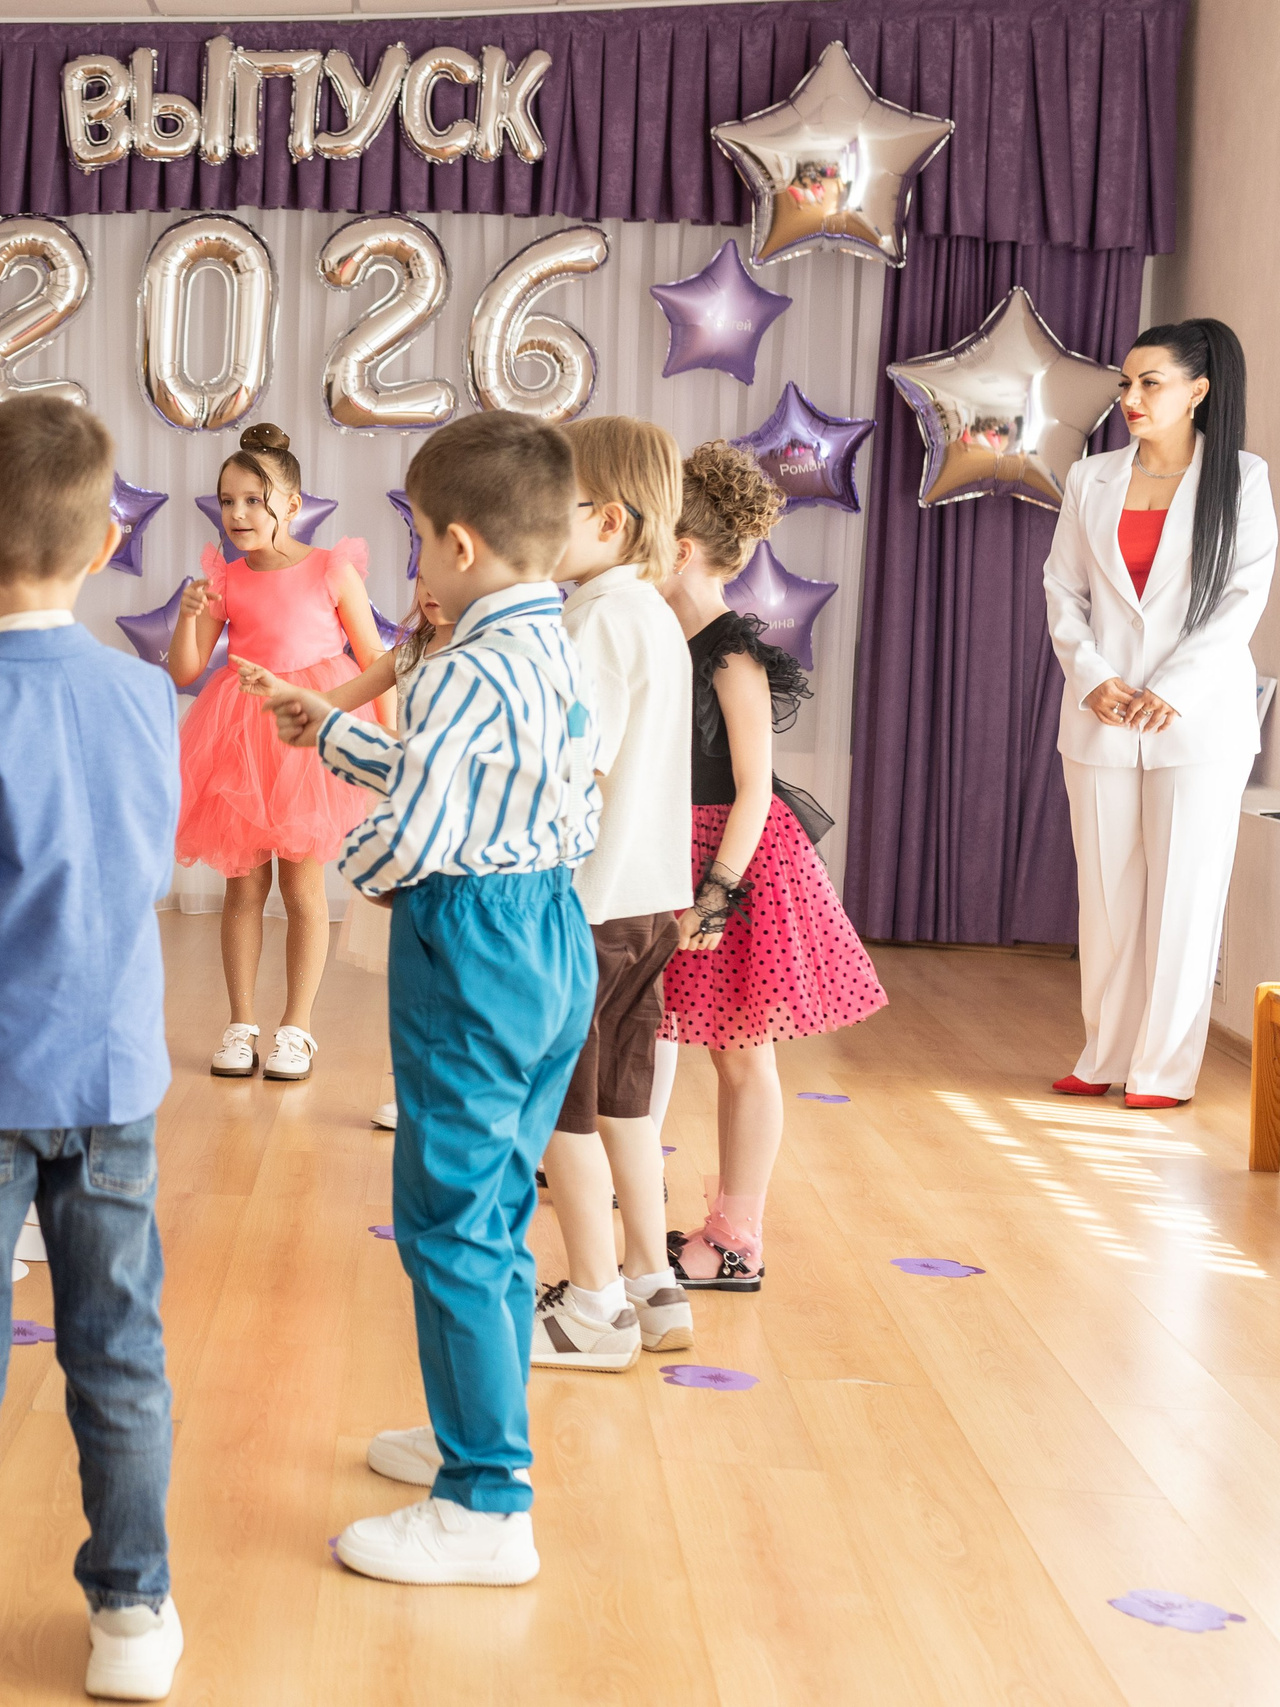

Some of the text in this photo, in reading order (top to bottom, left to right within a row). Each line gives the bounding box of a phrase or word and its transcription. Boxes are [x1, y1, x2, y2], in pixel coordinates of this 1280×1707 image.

[60, 34, 553, 173] ВЫПУСК
[779, 460, 826, 476] Роман
[766, 617, 795, 630] ина
